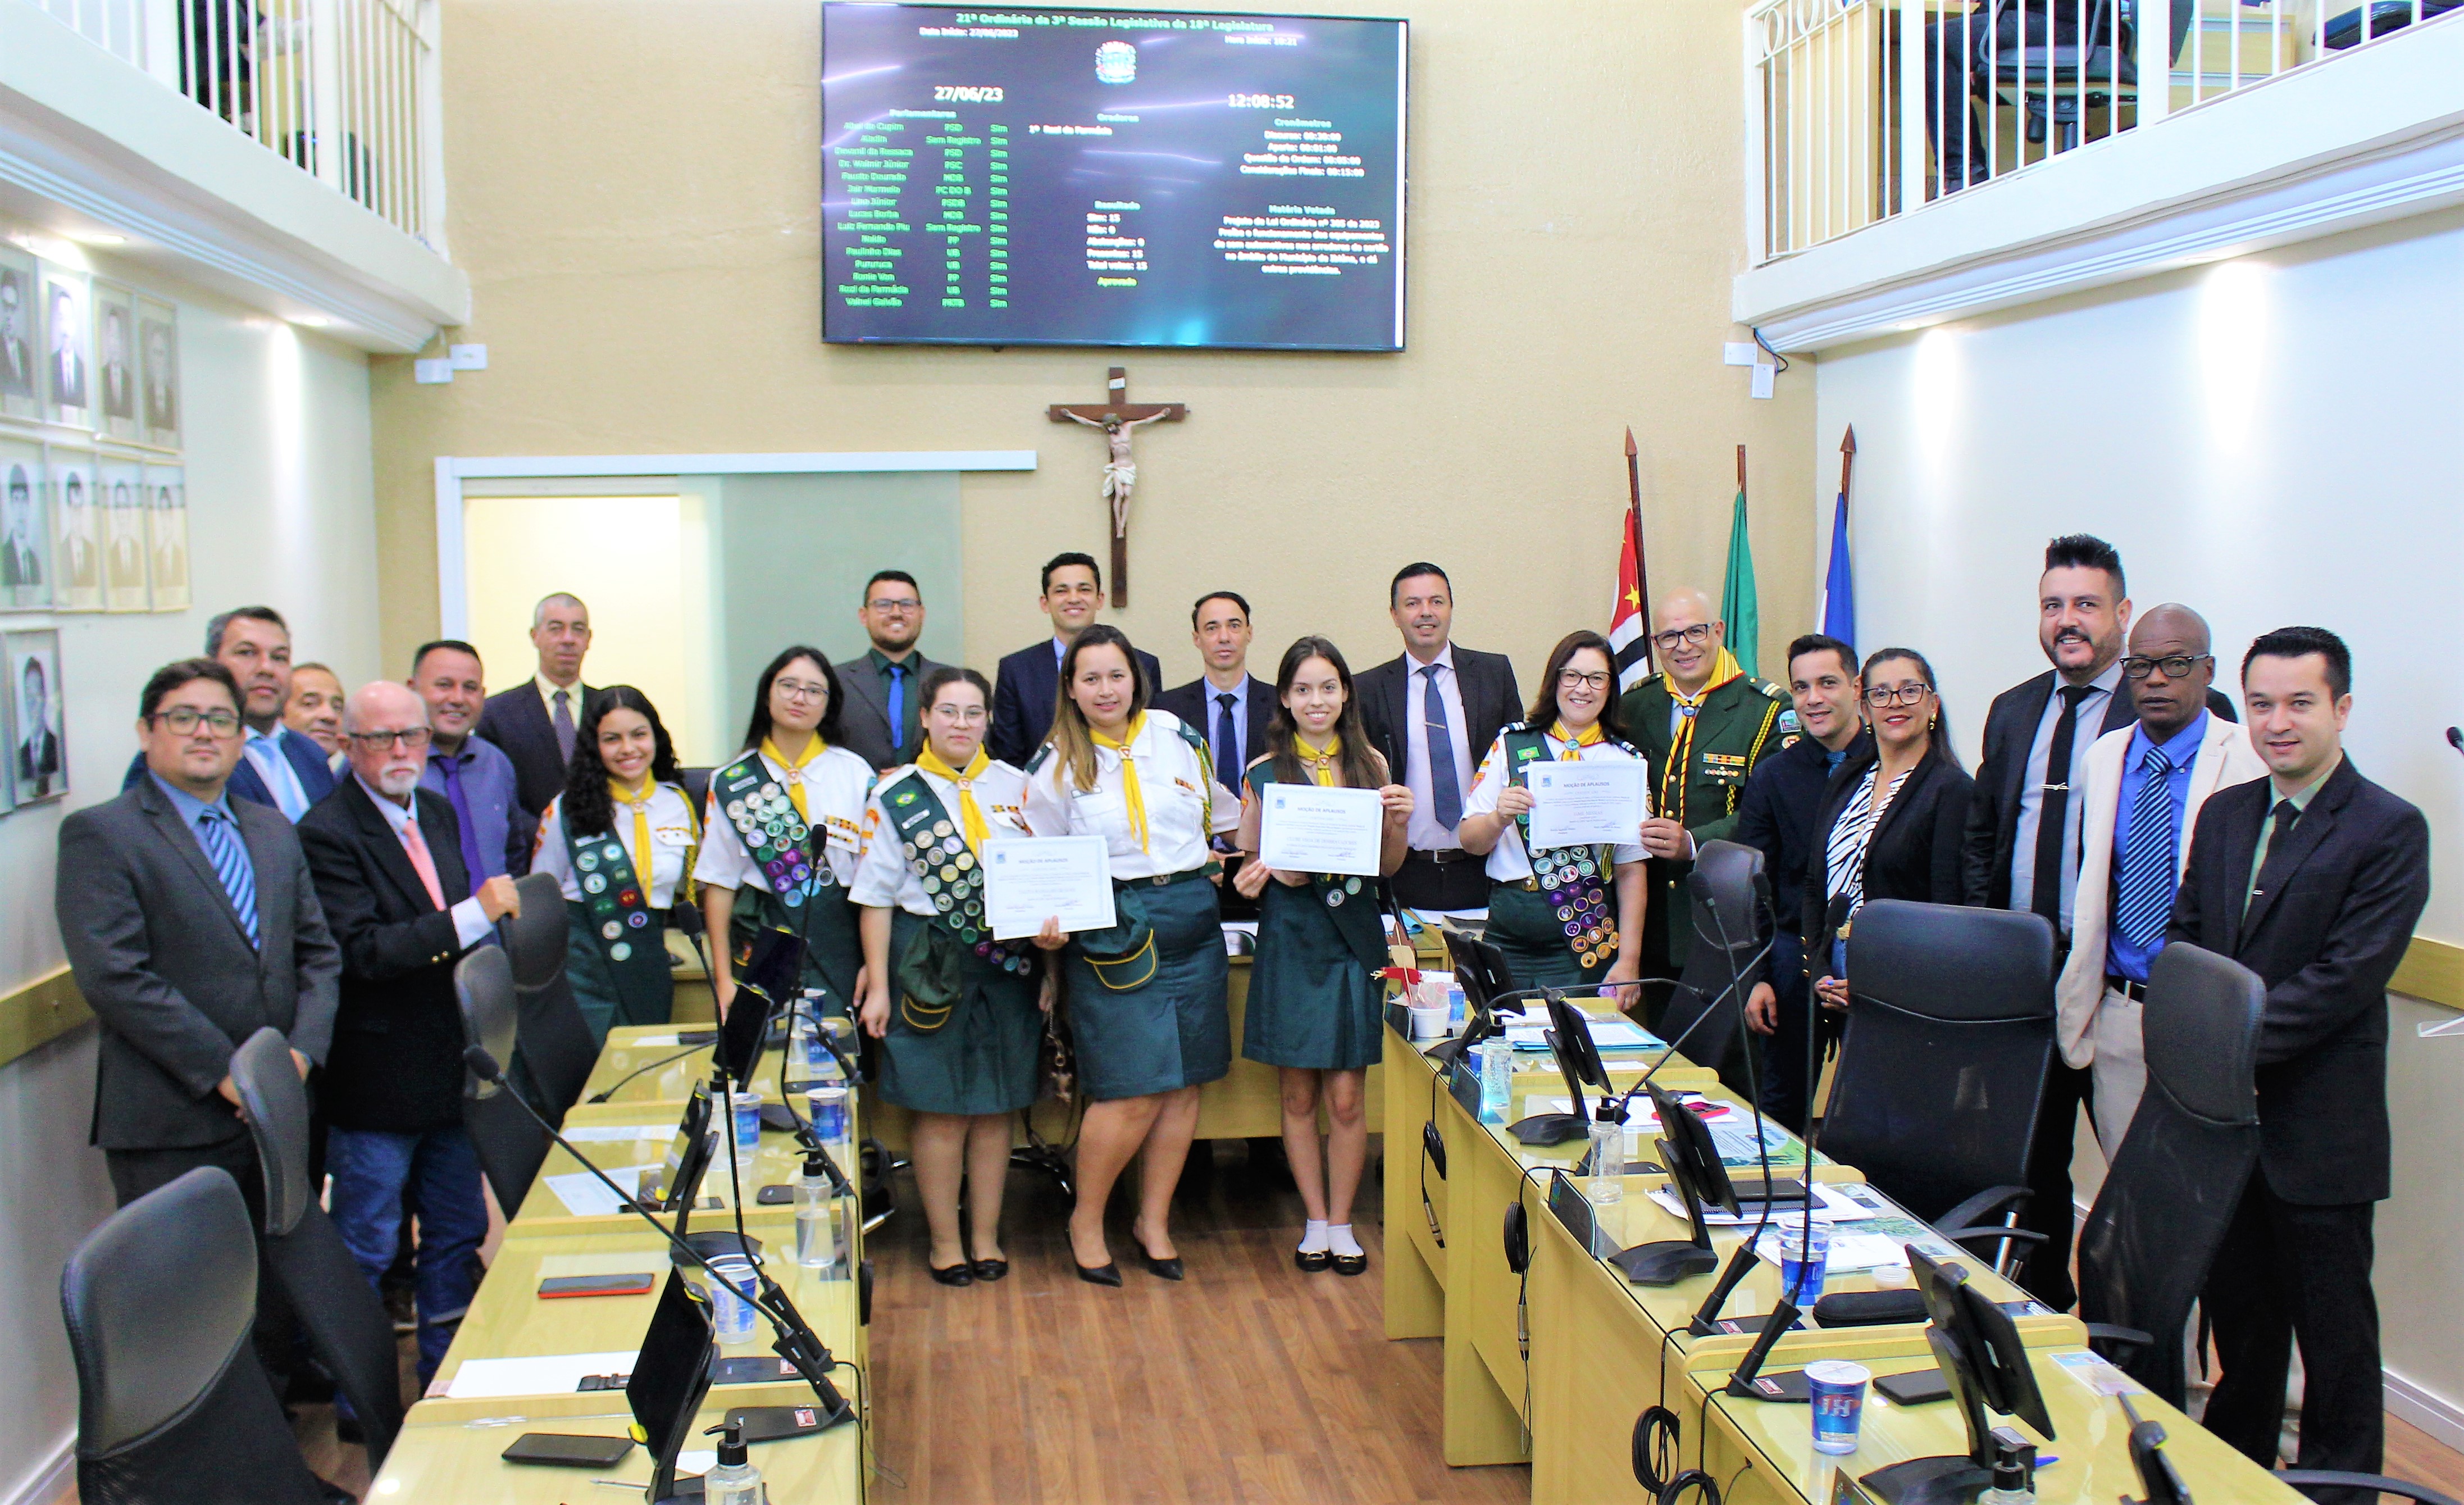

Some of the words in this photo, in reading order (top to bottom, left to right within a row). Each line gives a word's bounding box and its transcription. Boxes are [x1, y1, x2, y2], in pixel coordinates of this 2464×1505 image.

[1035, 15, 1050, 24] da
[1067, 16, 1108, 26] Sessão
[1110, 17, 1170, 29] Legislativa
[1172, 19, 1187, 29] da
[1211, 20, 1274, 32] Legislatura
[934, 86, 1003, 103] 27/06/23
[1228, 94, 1294, 110] 12:08:52
[990, 124, 1008, 133] Sim
[926, 135, 946, 144] Sem
[990, 137, 1008, 146] Sim
[990, 149, 1008, 158] Sim
[990, 162, 1008, 171] Sim
[990, 175, 1008, 184] Sim
[990, 187, 1008, 196] Sim
[990, 199, 1008, 208] Sim
[990, 212, 1008, 221] Sim
[926, 223, 945, 233] Sem
[990, 224, 1008, 233] Sim
[990, 237, 1008, 246] Sim
[990, 249, 1008, 258] Sim
[990, 262, 1008, 271] Sim
[990, 274, 1008, 283] Sim
[990, 287, 1008, 295] Sim
[990, 299, 1008, 308] Sim
